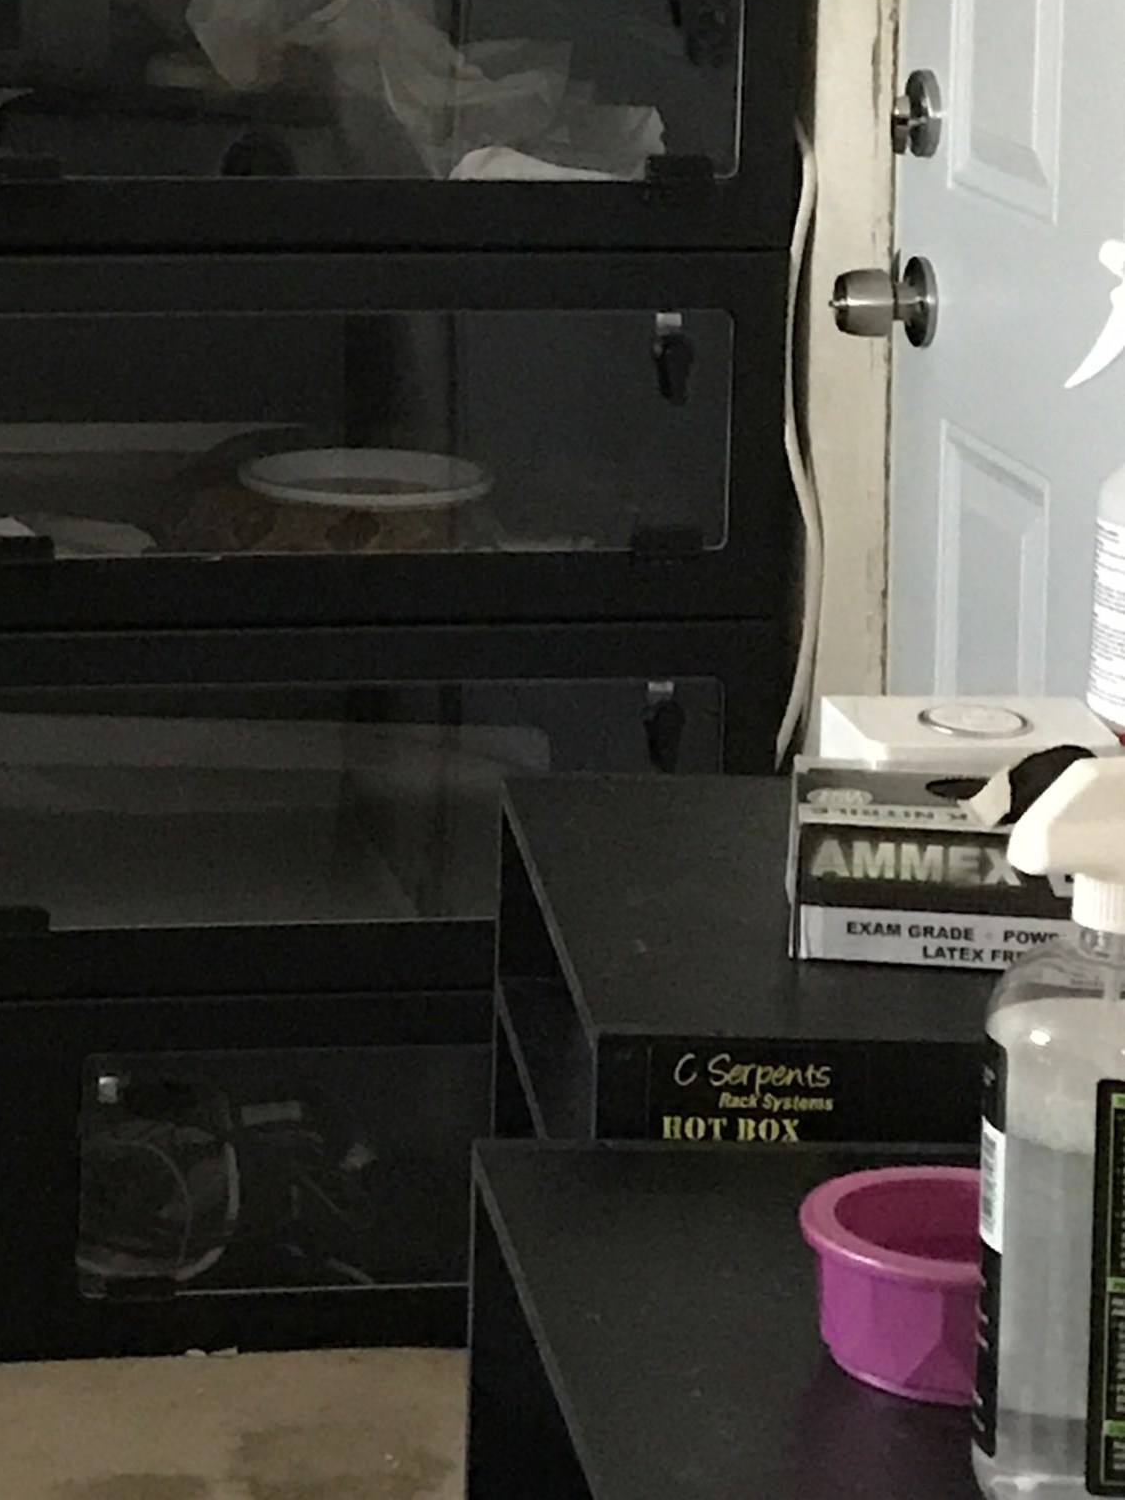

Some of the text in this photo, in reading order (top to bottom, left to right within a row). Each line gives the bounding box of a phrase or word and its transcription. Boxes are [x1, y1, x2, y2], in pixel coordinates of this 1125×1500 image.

[810, 838, 1022, 887] AMMEX
[846, 921, 901, 937] EXAM
[908, 926, 975, 942] GRADE
[922, 946, 983, 962] LATEX
[674, 1053, 832, 1097] C Serpents
[719, 1092, 834, 1112] Rack Systems
[662, 1115, 799, 1142] HOT BOX
